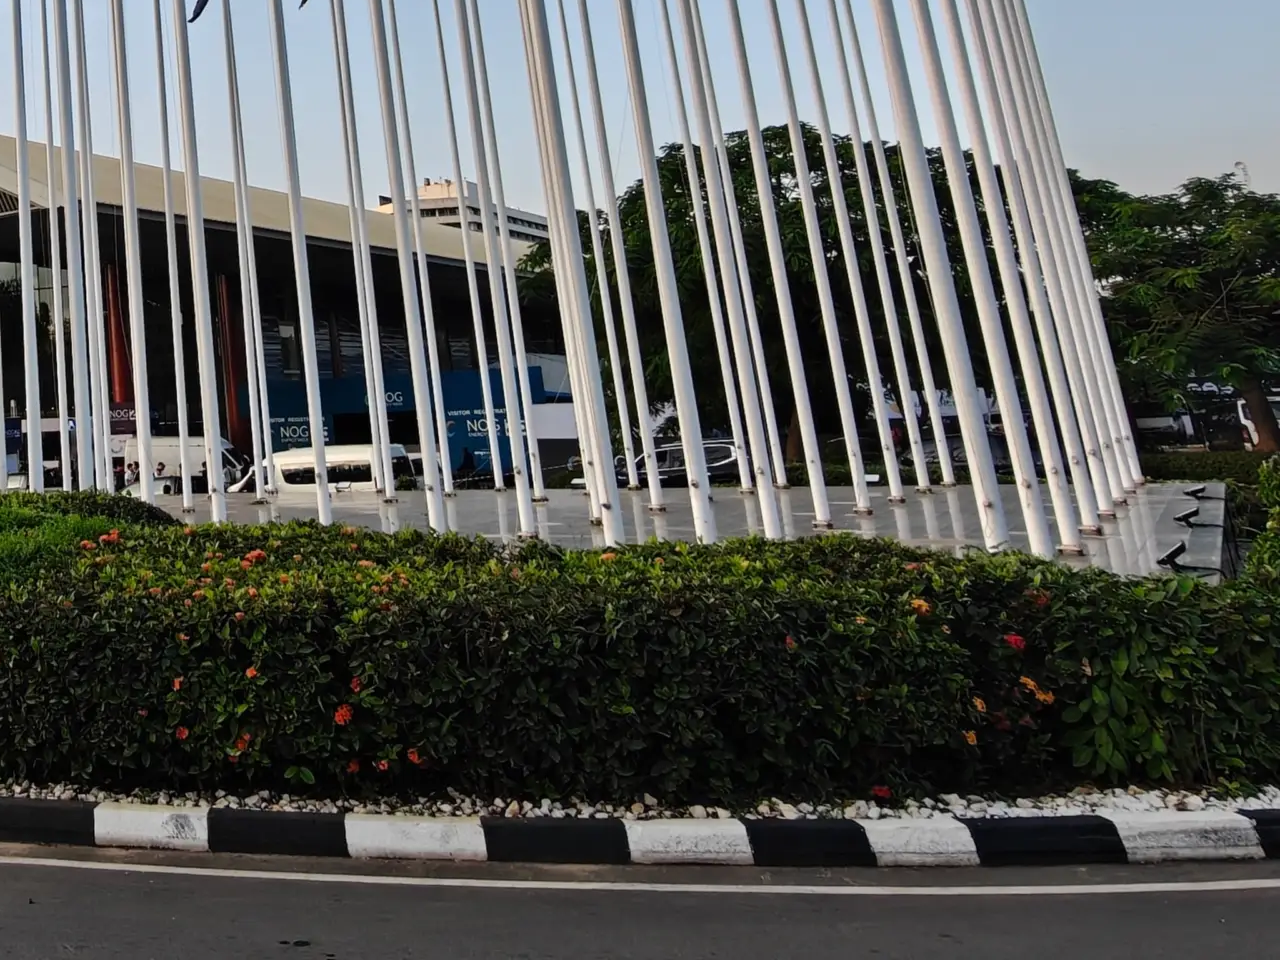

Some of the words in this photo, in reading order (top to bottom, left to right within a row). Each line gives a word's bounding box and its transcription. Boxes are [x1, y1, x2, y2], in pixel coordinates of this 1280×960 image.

[385, 392, 403, 402] OG
[447, 409, 471, 417] VISITOR
[280, 425, 309, 438] NOG
